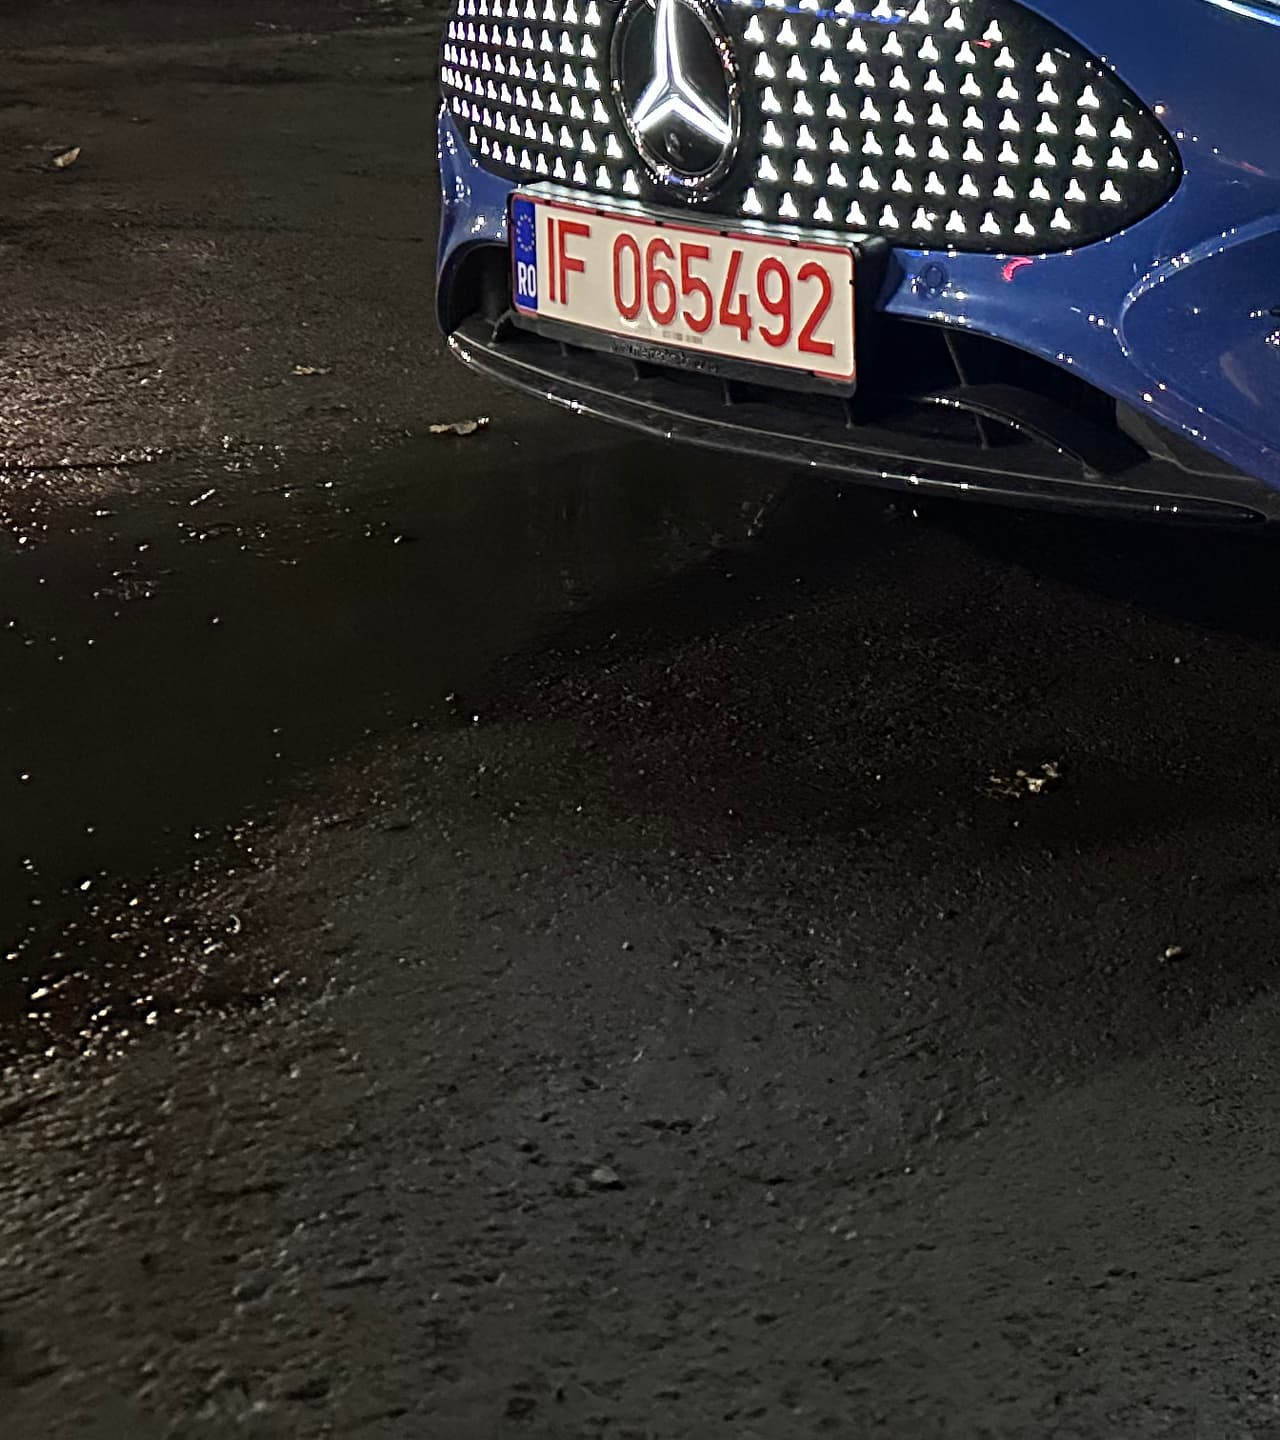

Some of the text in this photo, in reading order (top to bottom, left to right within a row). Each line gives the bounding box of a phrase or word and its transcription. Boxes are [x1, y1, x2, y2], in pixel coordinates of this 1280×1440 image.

[517, 261, 537, 298] RO
[547, 217, 834, 356] IF 065492
